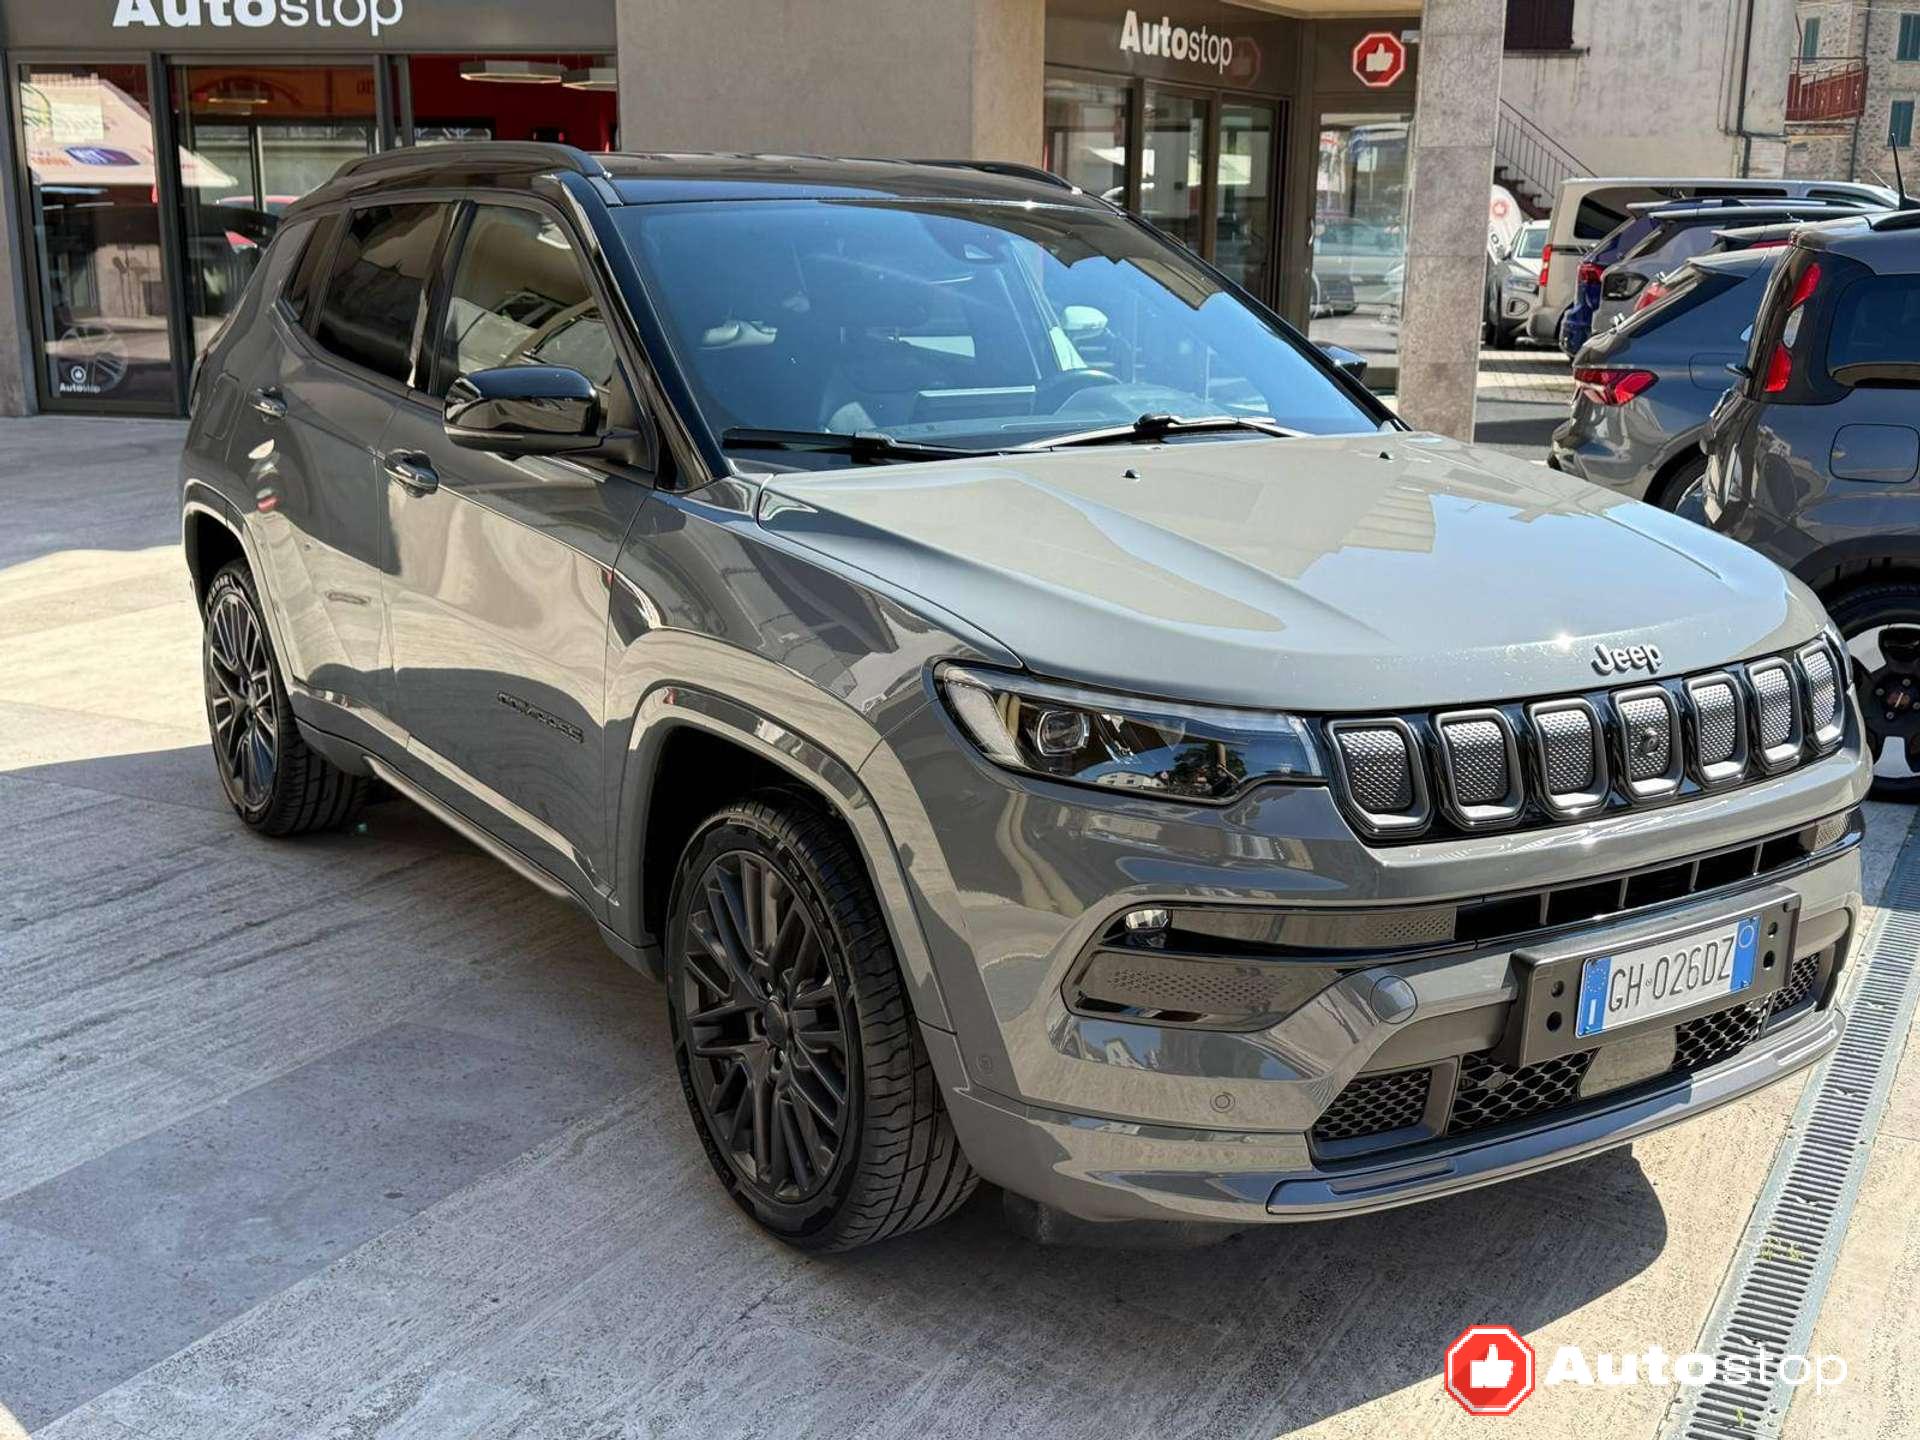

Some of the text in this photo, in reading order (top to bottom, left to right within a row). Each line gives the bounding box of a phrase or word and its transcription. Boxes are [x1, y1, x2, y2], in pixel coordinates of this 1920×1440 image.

[112, 0, 403, 36] Autostop
[1120, 9, 1233, 74] Autostop
[1591, 643, 1662, 675] Jeep
[1608, 963, 1644, 1012] GH
[1652, 935, 1736, 1000] 026DZ
